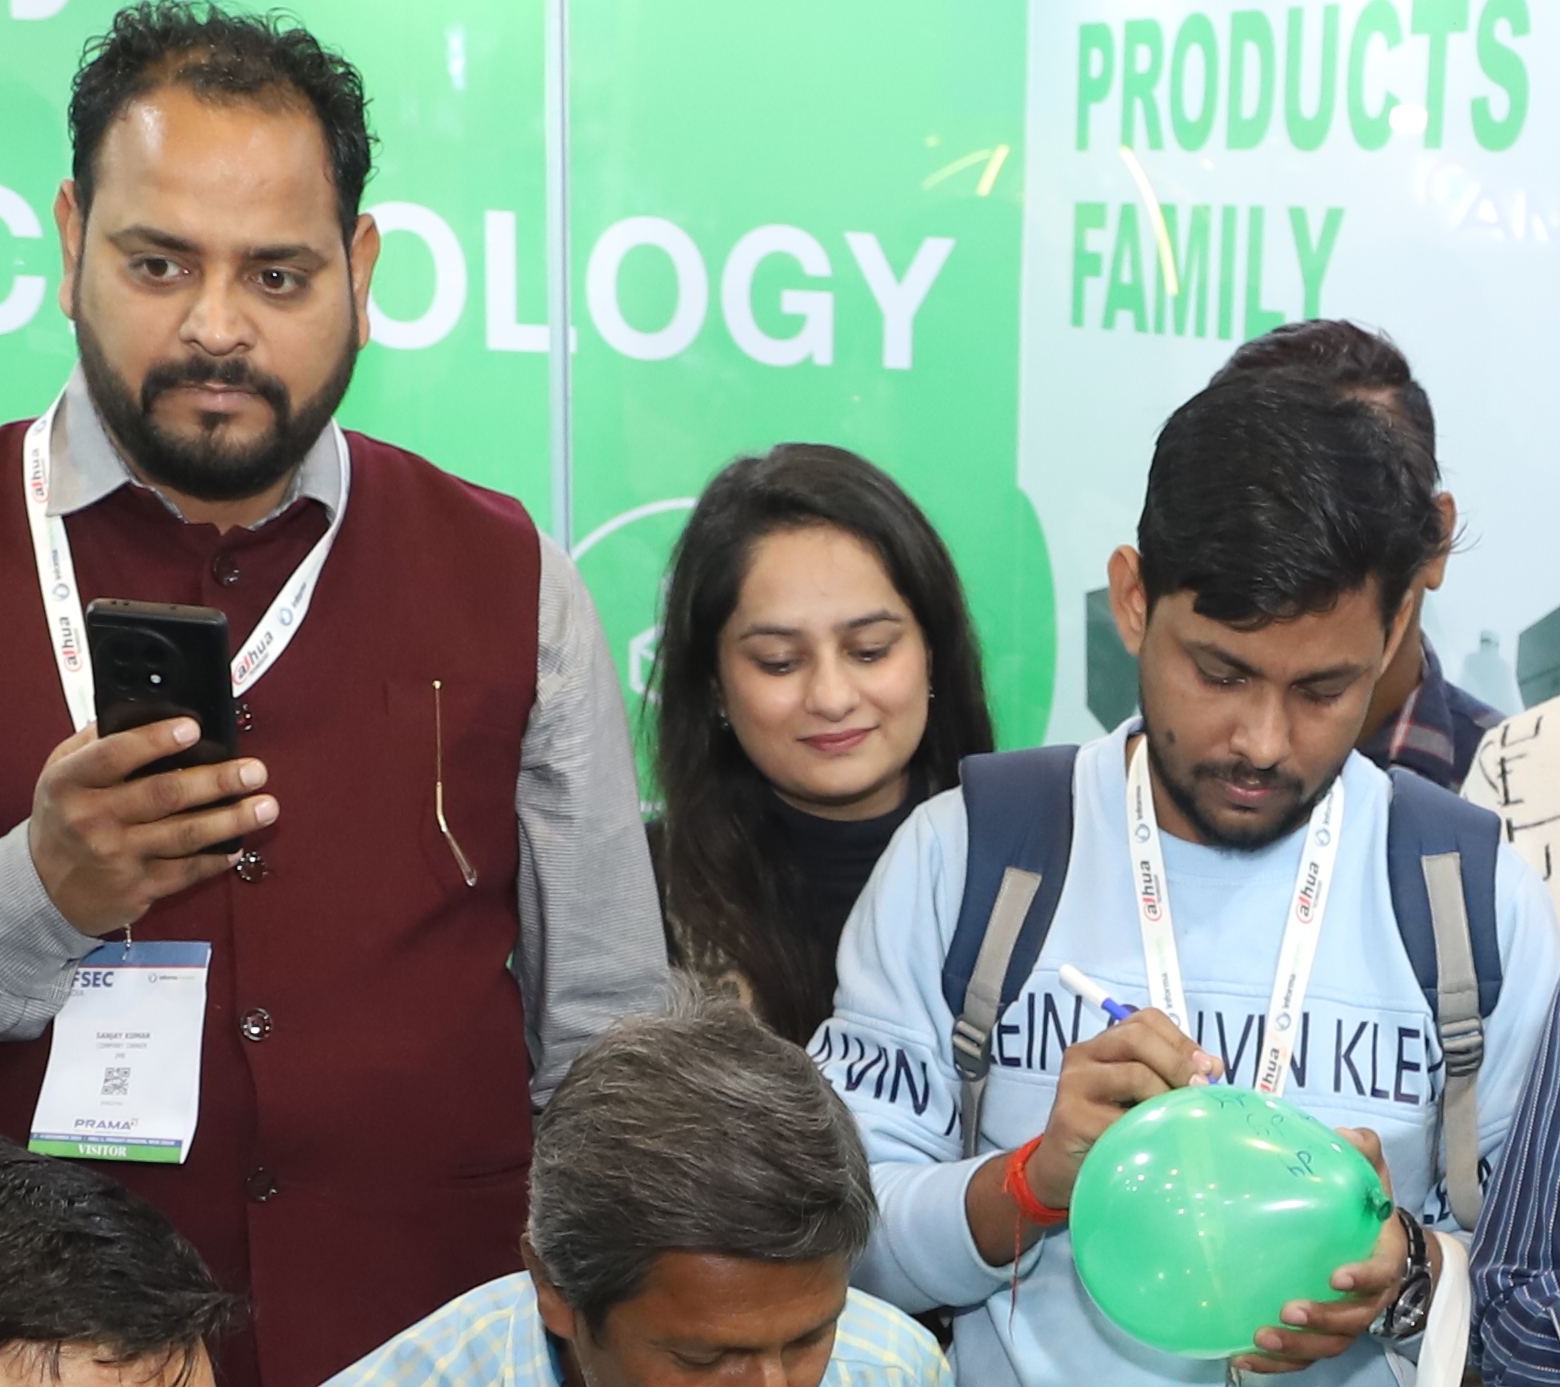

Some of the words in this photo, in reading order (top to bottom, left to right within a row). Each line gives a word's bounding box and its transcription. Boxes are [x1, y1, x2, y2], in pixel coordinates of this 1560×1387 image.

[1076, 0, 1531, 152] PRODUCTS
[1070, 202, 1345, 341] FAMILY
[71, 971, 114, 988] FSEC
[74, 1118, 132, 1131] PRAMA
[77, 1143, 128, 1158] VISITOR
